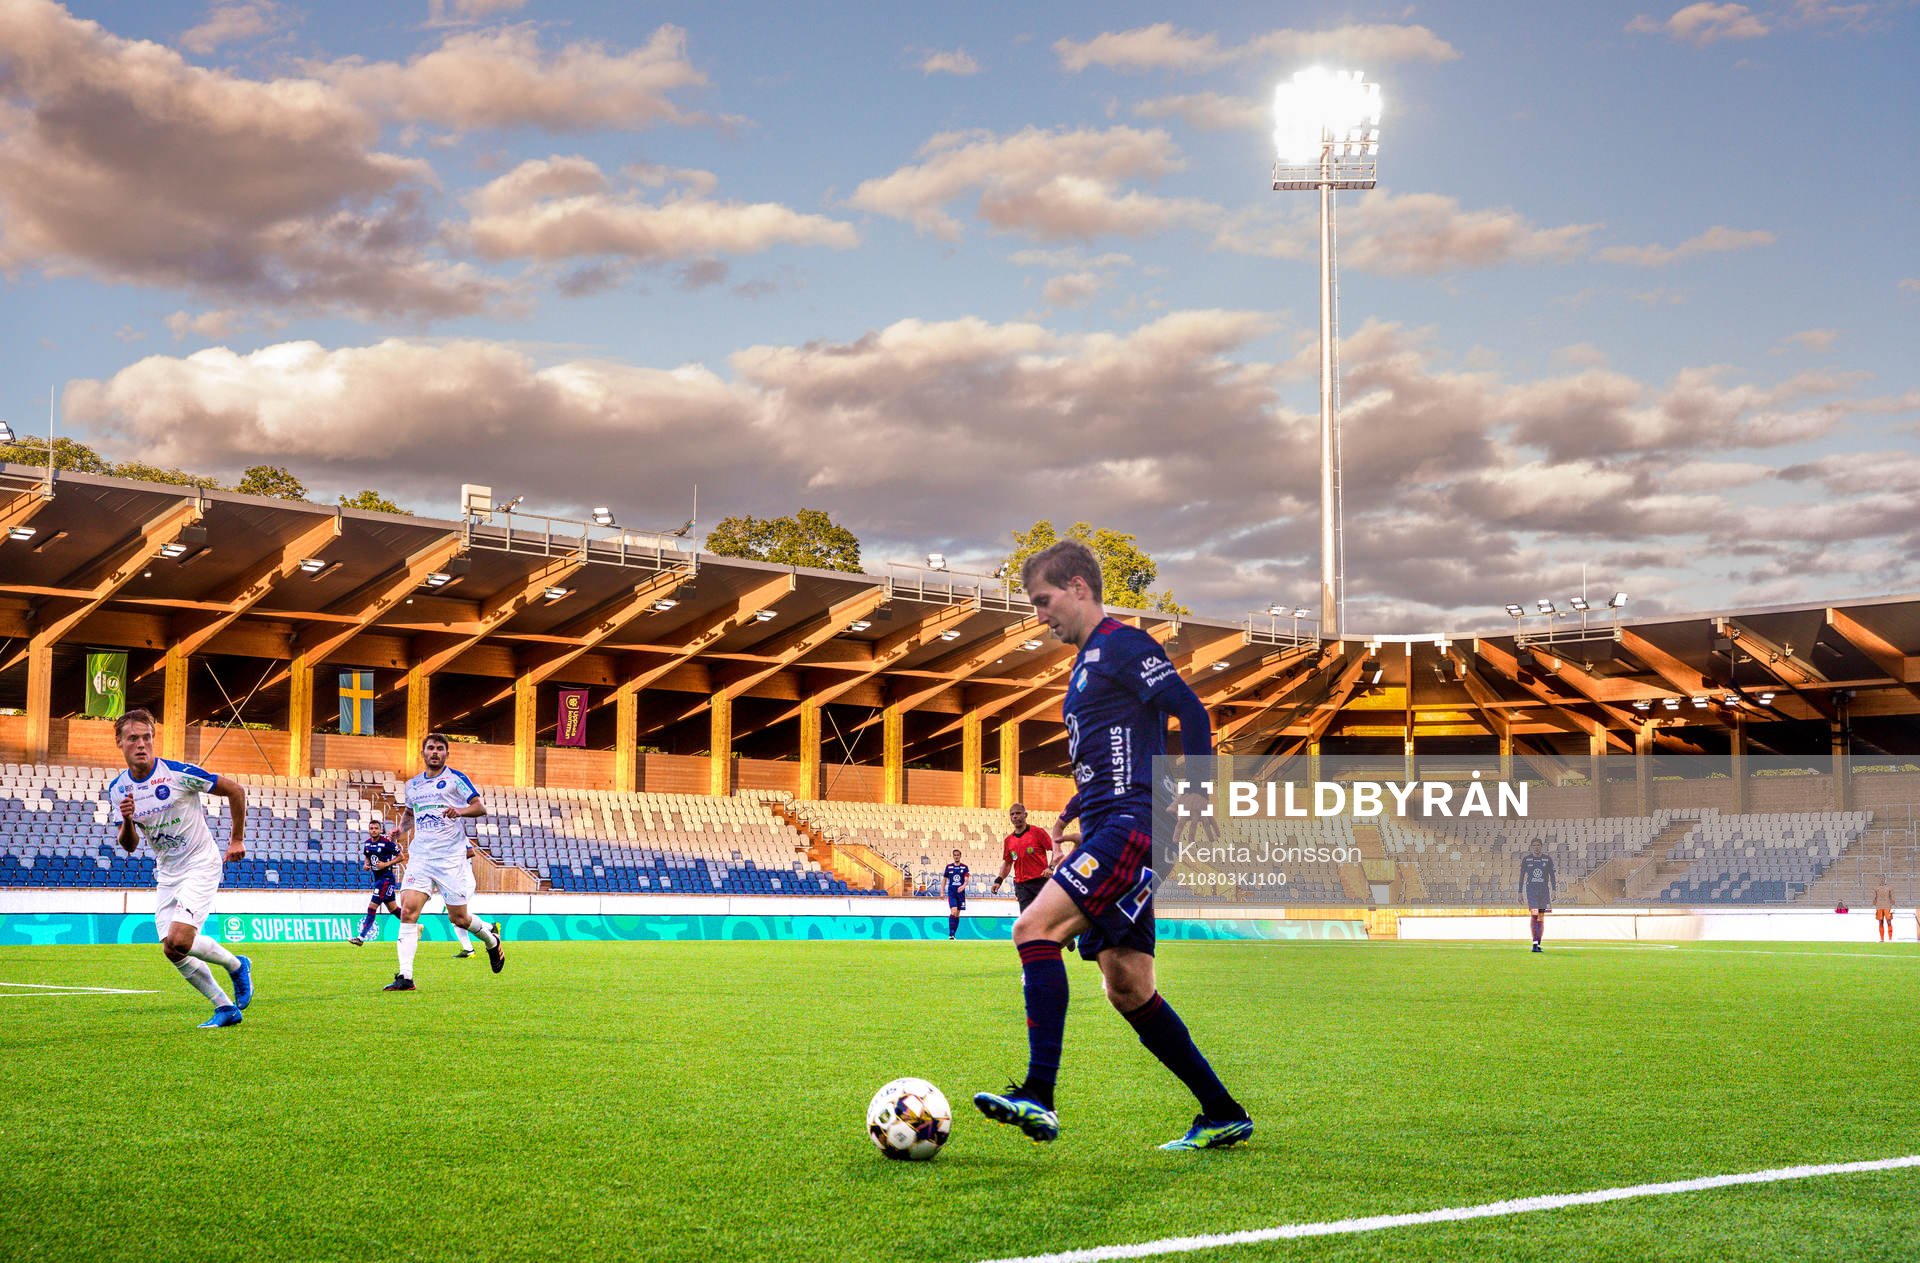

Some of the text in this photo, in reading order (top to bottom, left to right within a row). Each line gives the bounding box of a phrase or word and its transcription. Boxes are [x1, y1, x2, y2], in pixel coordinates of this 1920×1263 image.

[1141, 656, 1163, 670] ICA
[1110, 726, 1126, 796] EMILSHUS
[1060, 866, 1089, 895] BALCO
[252, 918, 353, 941] SUPERETTAN
